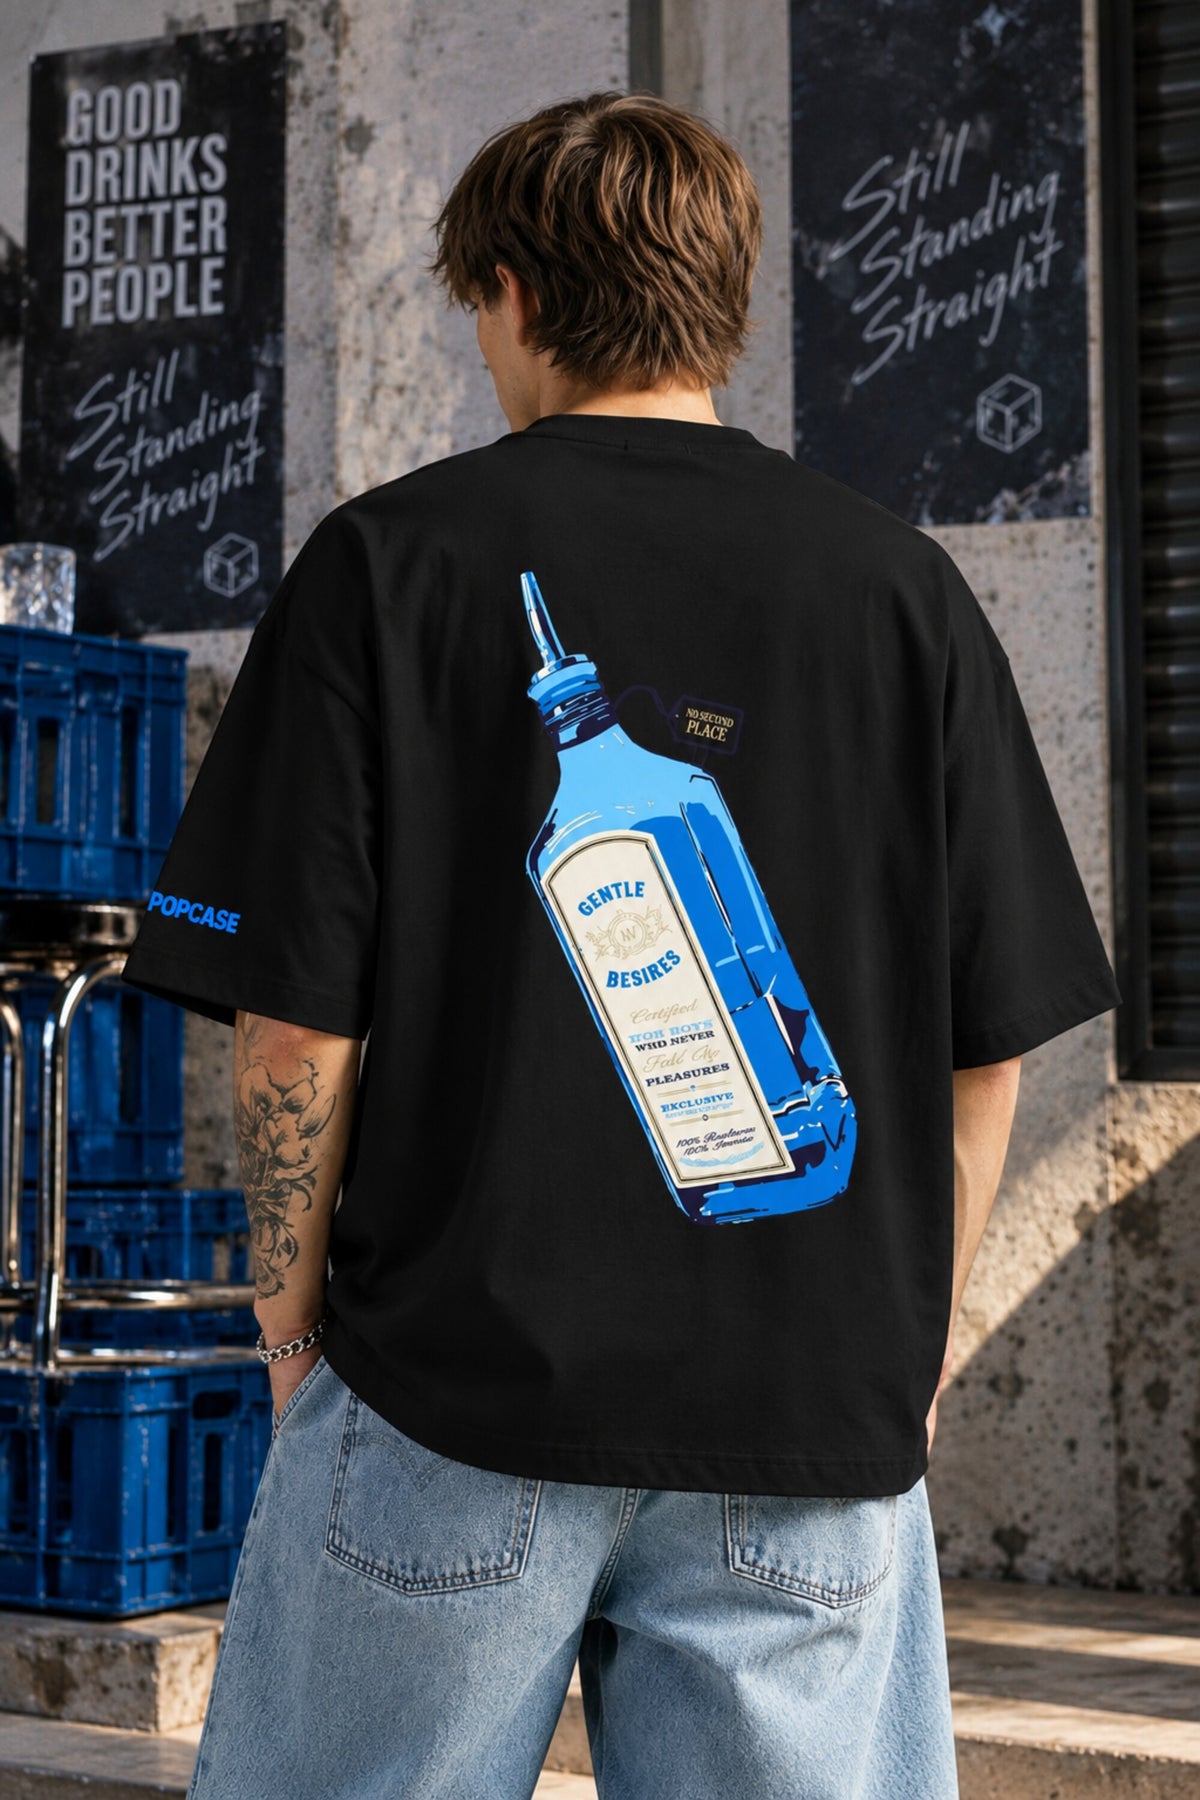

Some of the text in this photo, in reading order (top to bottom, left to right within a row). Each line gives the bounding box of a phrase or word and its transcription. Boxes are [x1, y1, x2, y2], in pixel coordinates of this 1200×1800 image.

[65, 78, 181, 147] GOOD
[64, 133, 228, 206] DRINKS
[828, 120, 971, 261] Still
[63, 195, 227, 268] BETTER
[851, 170, 1060, 315] Standing
[61, 256, 225, 328] PEOPLE
[852, 228, 1065, 385] Straight
[66, 348, 180, 461] Still
[88, 389, 262, 505] Standing
[93, 436, 267, 562] Straight
[686, 719, 728, 742] PLACE
[147, 891, 241, 934] POPCASE
[578, 881, 645, 916] GENTLE
[606, 950, 681, 988] BESIRES
[670, 1030, 716, 1046] NEVER
[645, 1063, 730, 1087] PLEASURES
[660, 1092, 734, 1112] EXCLUSIVE
